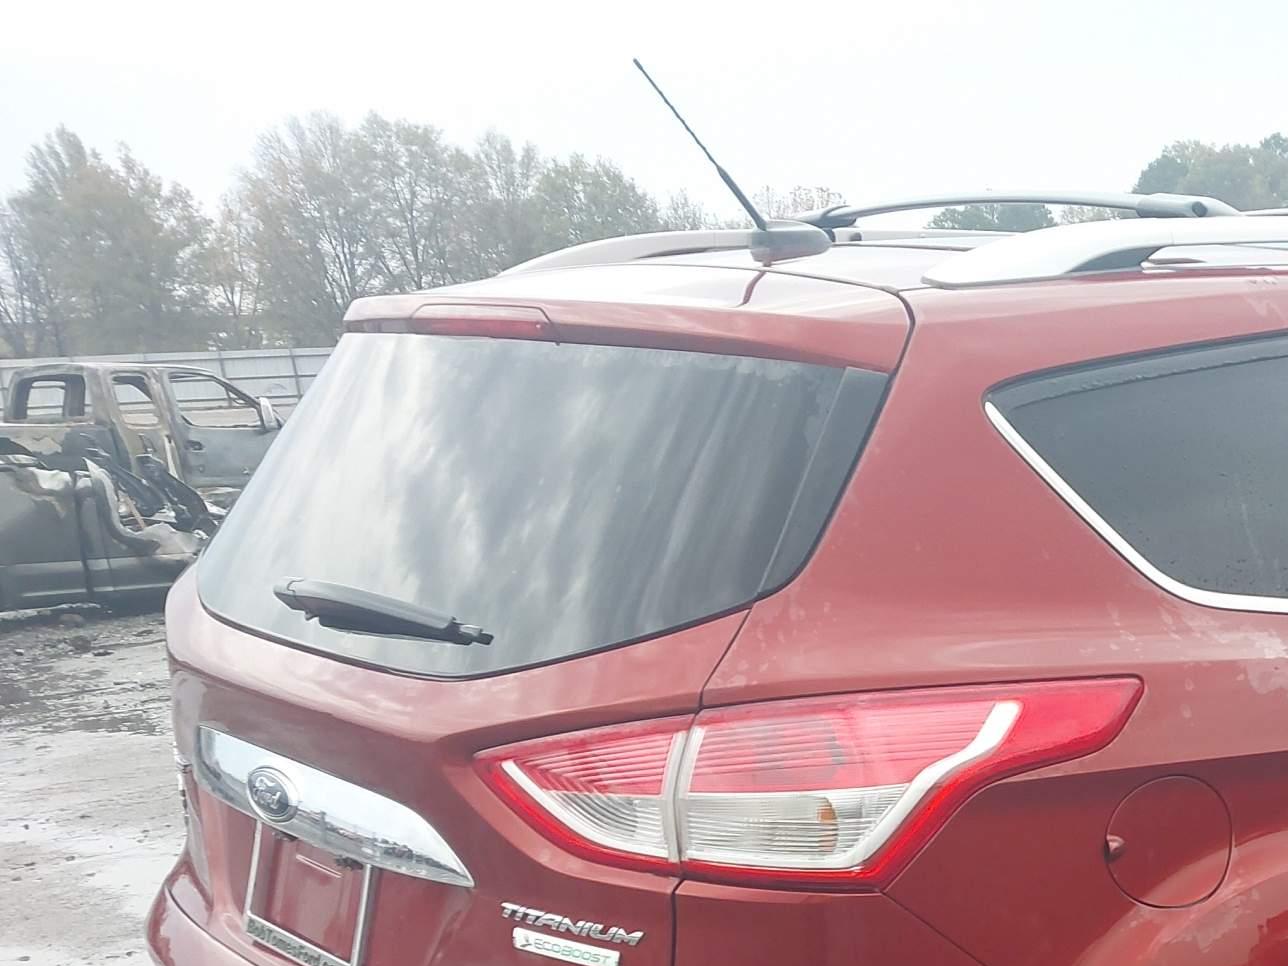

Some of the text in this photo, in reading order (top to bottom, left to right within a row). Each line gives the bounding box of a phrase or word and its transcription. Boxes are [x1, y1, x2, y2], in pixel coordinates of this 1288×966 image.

[253, 776, 282, 810] Ford
[501, 902, 645, 945] TITANIUM
[532, 938, 612, 965] ECOBOOST
